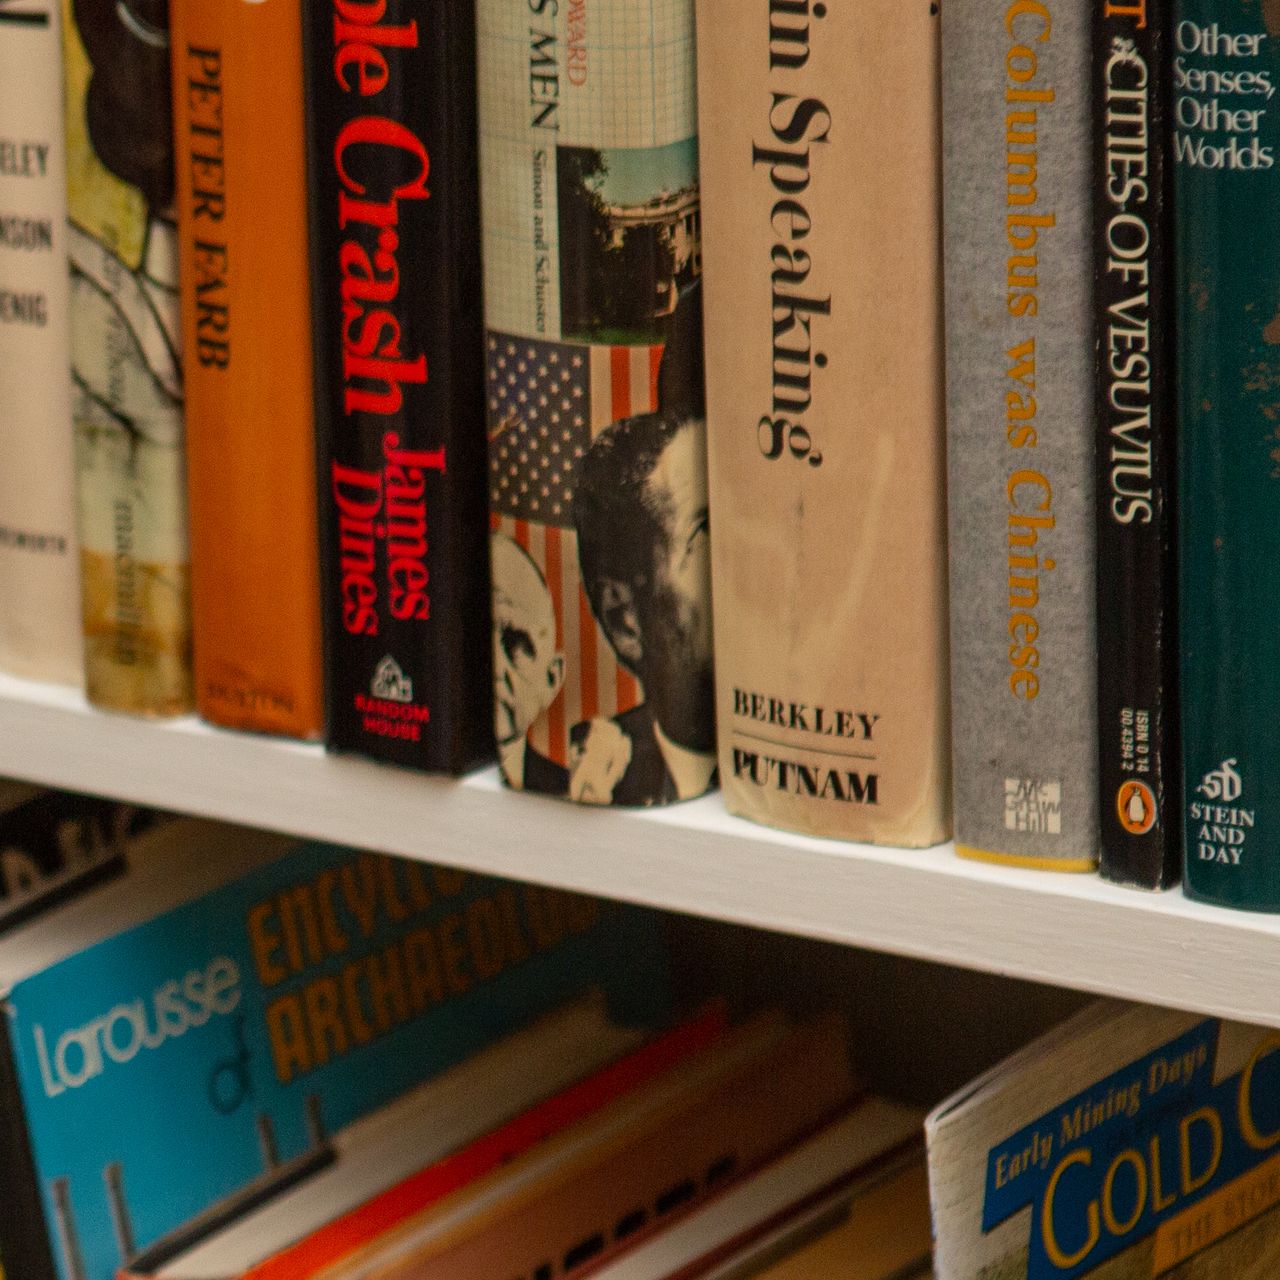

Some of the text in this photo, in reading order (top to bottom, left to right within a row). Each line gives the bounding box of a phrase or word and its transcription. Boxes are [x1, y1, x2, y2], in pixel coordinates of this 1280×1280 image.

[529, 27, 560, 132] MEN
[1173, 56, 1276, 100] Senses,
[1176, 20, 1267, 57] Other
[1173, 130, 1275, 170] Worlds
[1176, 96, 1266, 132] Other
[187, 42, 231, 372] PETER FARB
[532, 148, 550, 334] Simon and Schuster
[334, 115, 430, 416] Crash
[752, 92, 833, 469] Speaking
[1104, 51, 1153, 525] CITIES OF VESUVIUS
[1005, 0, 1057, 701] Columbus was Chinese
[331, 459, 385, 636] Dines
[383, 432, 446, 621] James
[354, 693, 430, 724] RANDOM
[362, 714, 422, 742] HOUSE
[733, 687, 880, 742] BERKLEY
[1135, 709, 1149, 741] ISBN
[732, 747, 879, 806] PUTNAM
[1190, 802, 1256, 827] STEIN
[1199, 822, 1246, 846] AND
[1199, 842, 1243, 866] DAY
[32, 955, 241, 1099] Larousse
[994, 1132, 1053, 1191] Early
[1059, 1077, 1142, 1147] Mining
[1041, 1105, 1223, 1270] GOLD
